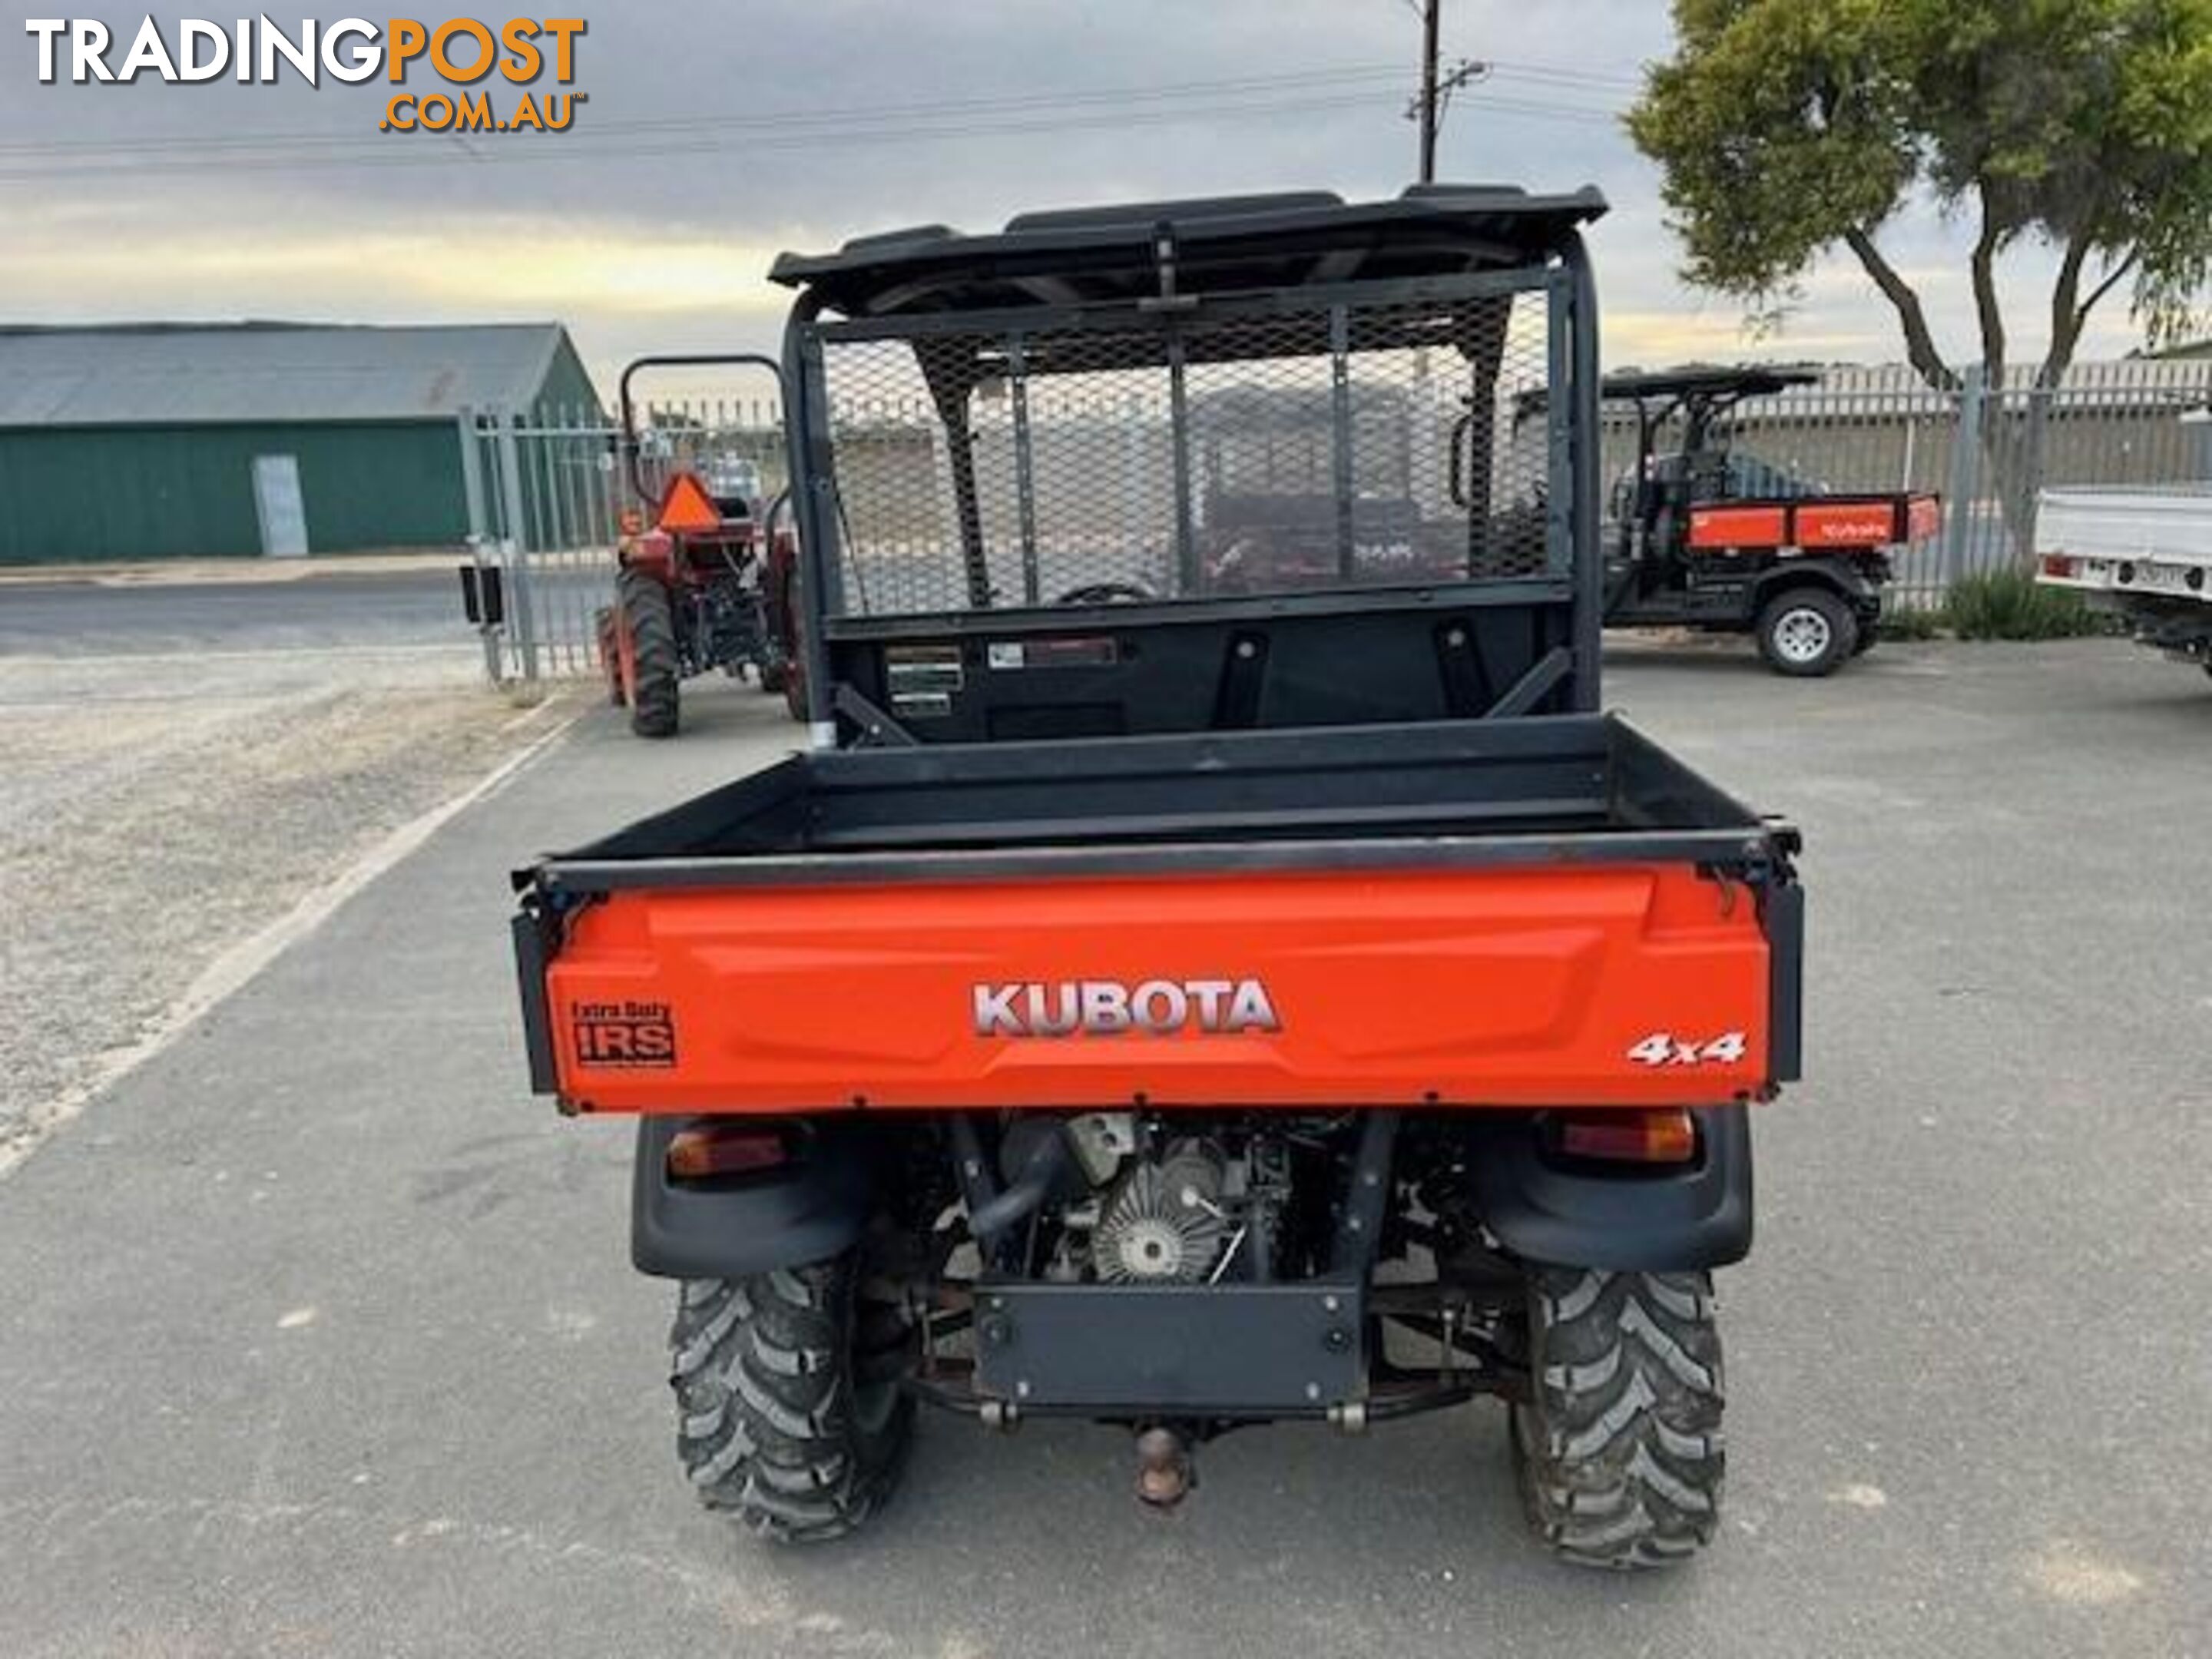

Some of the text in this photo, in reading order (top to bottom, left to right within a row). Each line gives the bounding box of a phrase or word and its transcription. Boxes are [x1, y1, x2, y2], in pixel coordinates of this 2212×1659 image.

[973, 979, 1281, 1035] KUBOTA
[578, 1026, 672, 1057] IRS
[1627, 1033, 1747, 1065] 4x4
